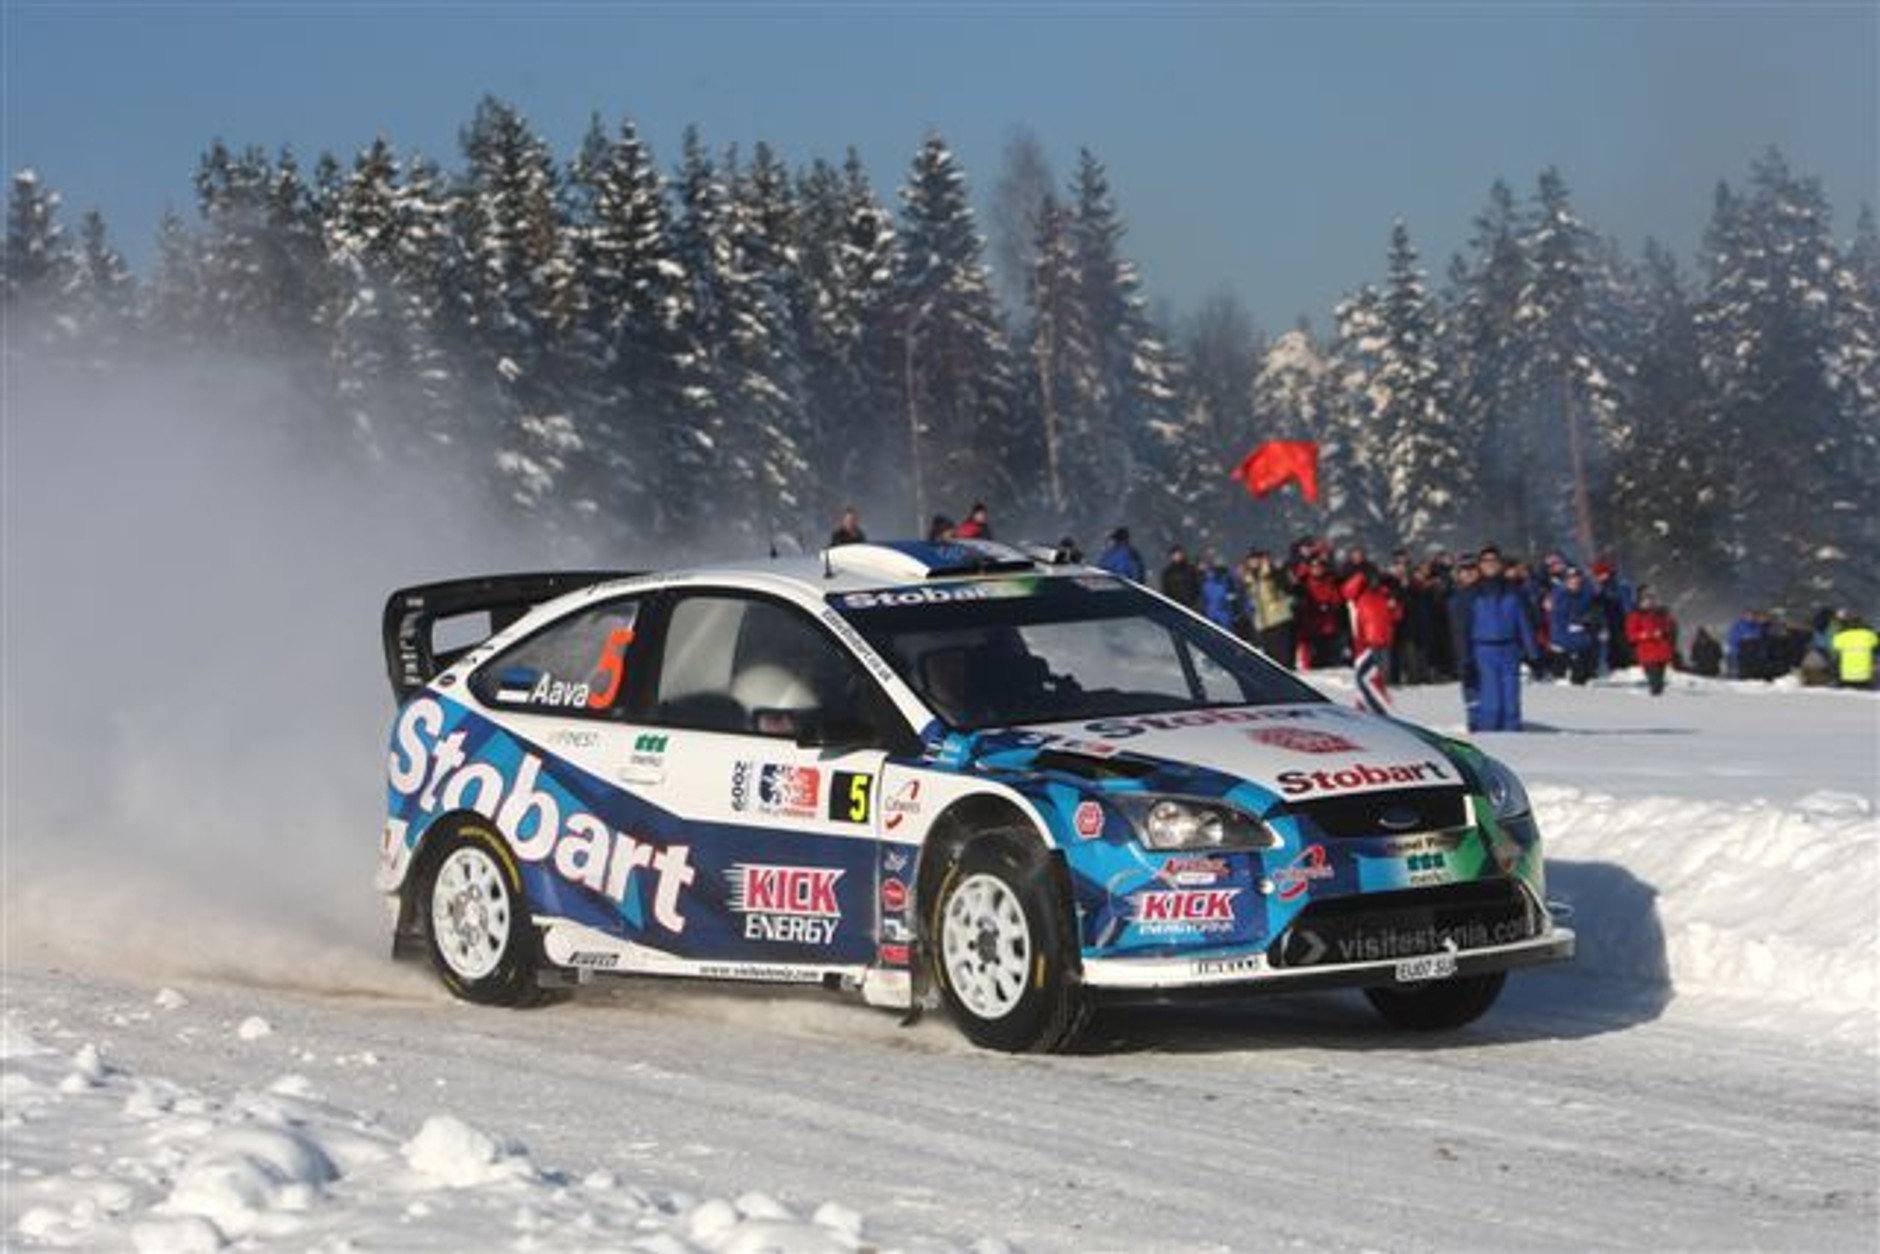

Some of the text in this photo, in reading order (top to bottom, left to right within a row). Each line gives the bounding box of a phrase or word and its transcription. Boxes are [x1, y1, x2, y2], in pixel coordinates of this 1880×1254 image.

[588, 629, 635, 708] 5
[532, 672, 589, 708] Aava
[1277, 760, 1449, 794] Stobart
[389, 697, 695, 934] Stobart
[849, 775, 869, 822] 5
[743, 868, 840, 914] KICK
[1141, 892, 1232, 920] KICK
[744, 914, 838, 945] ENERGY
